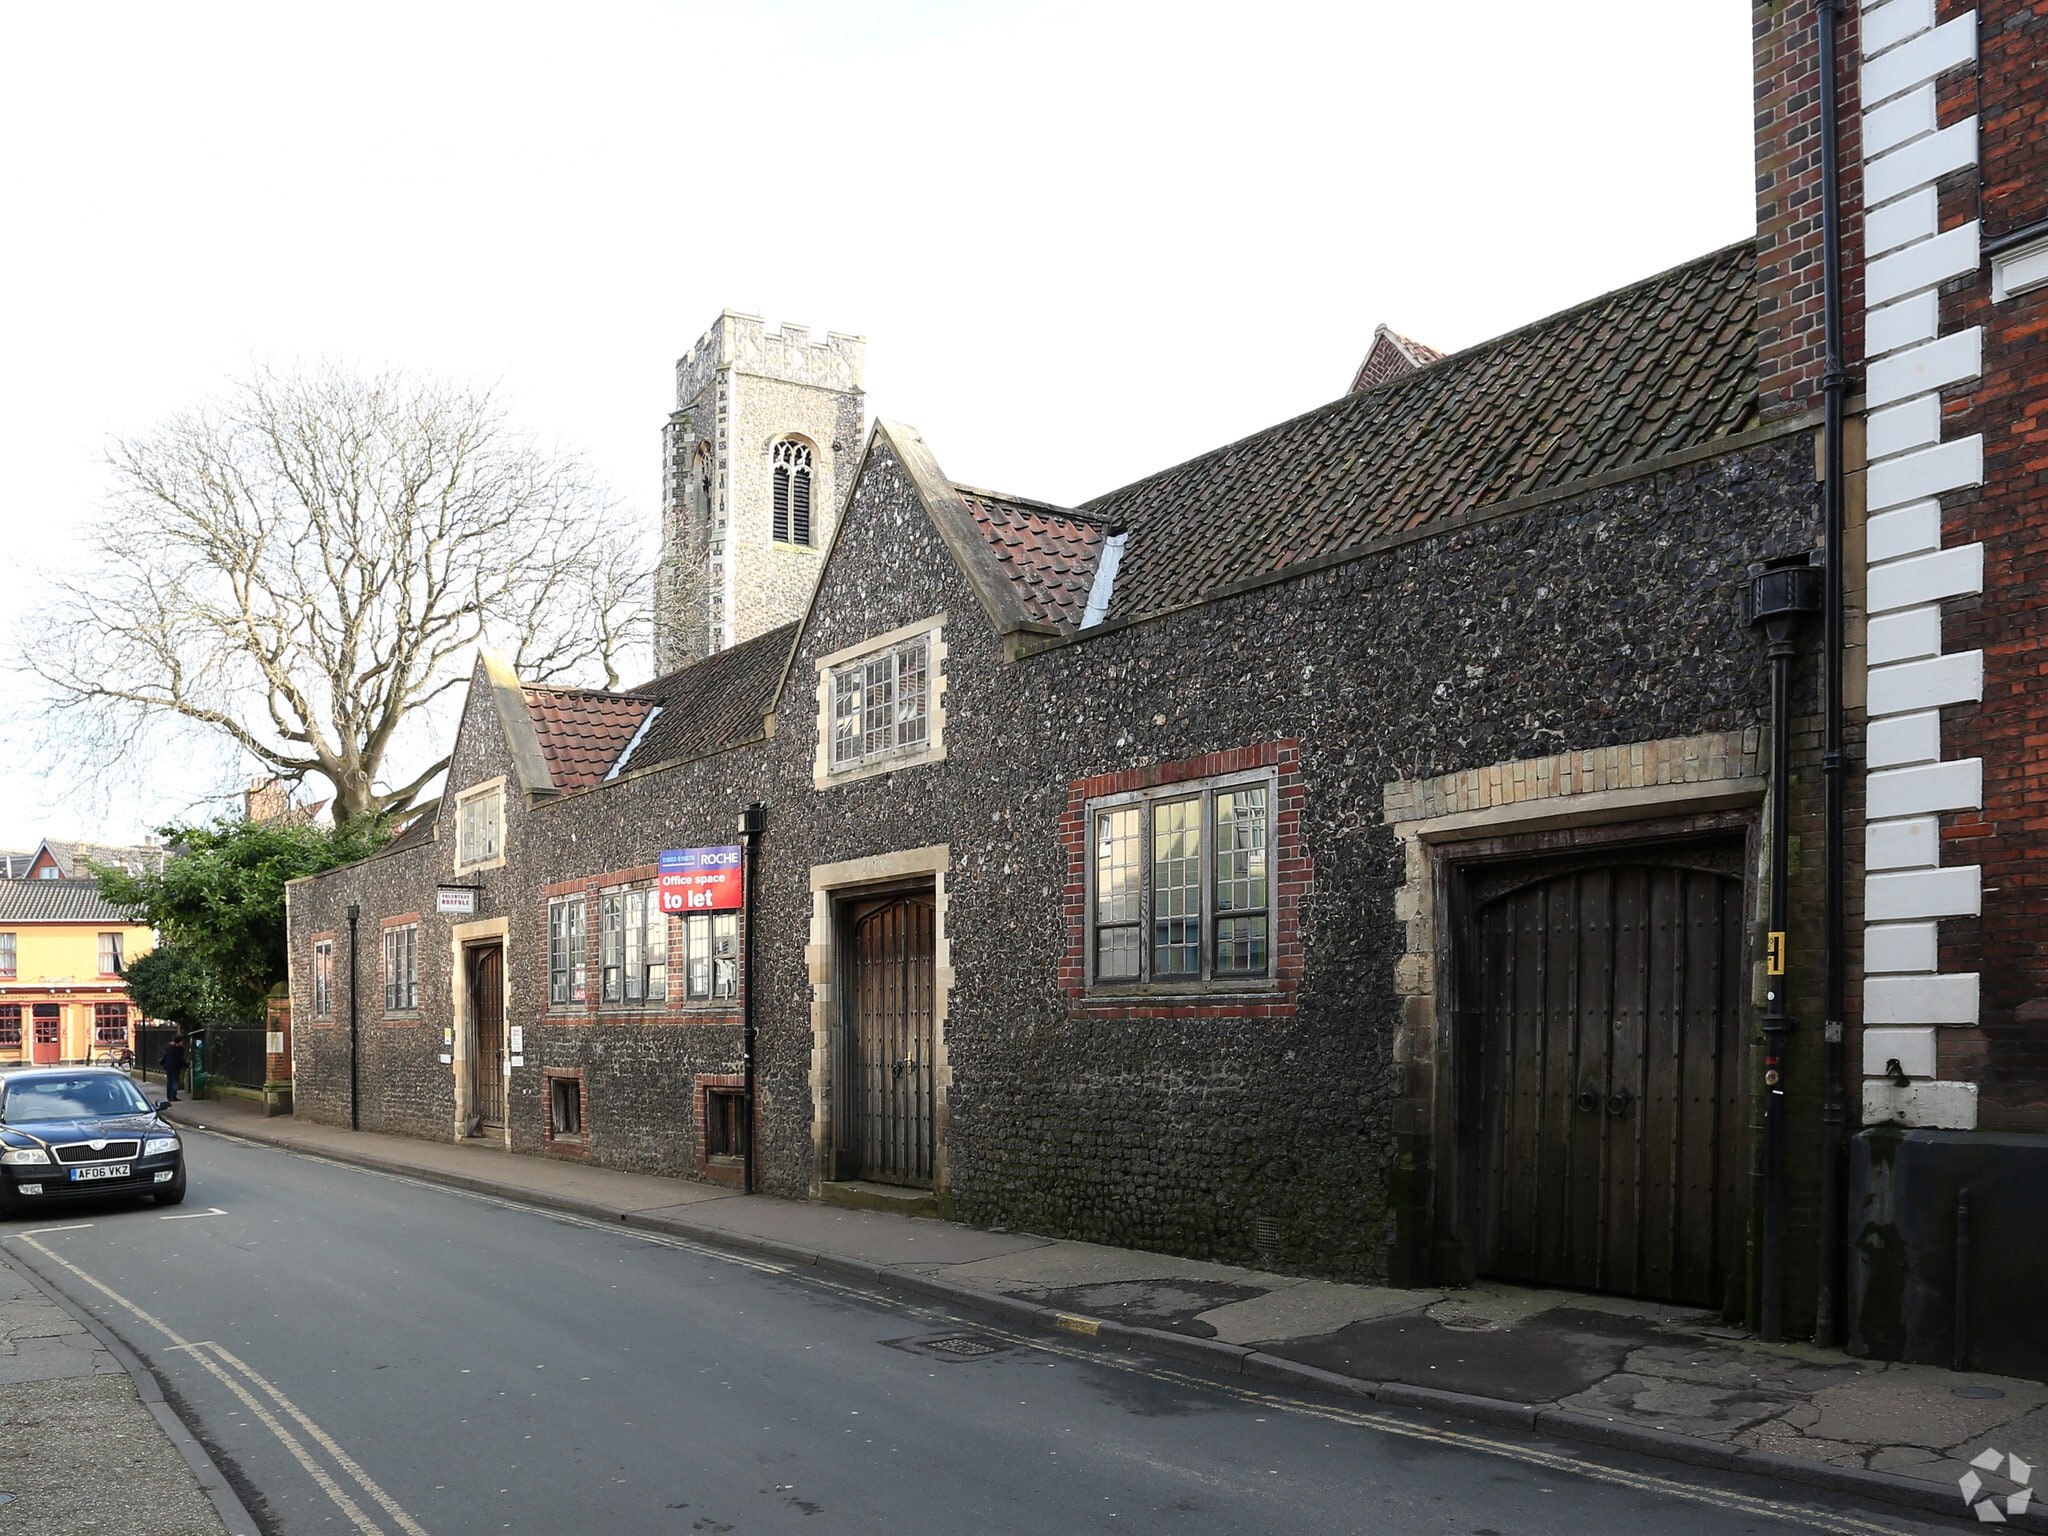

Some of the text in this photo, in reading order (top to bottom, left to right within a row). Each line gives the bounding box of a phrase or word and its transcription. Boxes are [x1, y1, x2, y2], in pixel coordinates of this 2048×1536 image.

[701, 853, 738, 865] ROCHE
[663, 875, 725, 886] Office space
[663, 889, 713, 909] to let
[79, 1165, 129, 1179] AF06 VKZ
